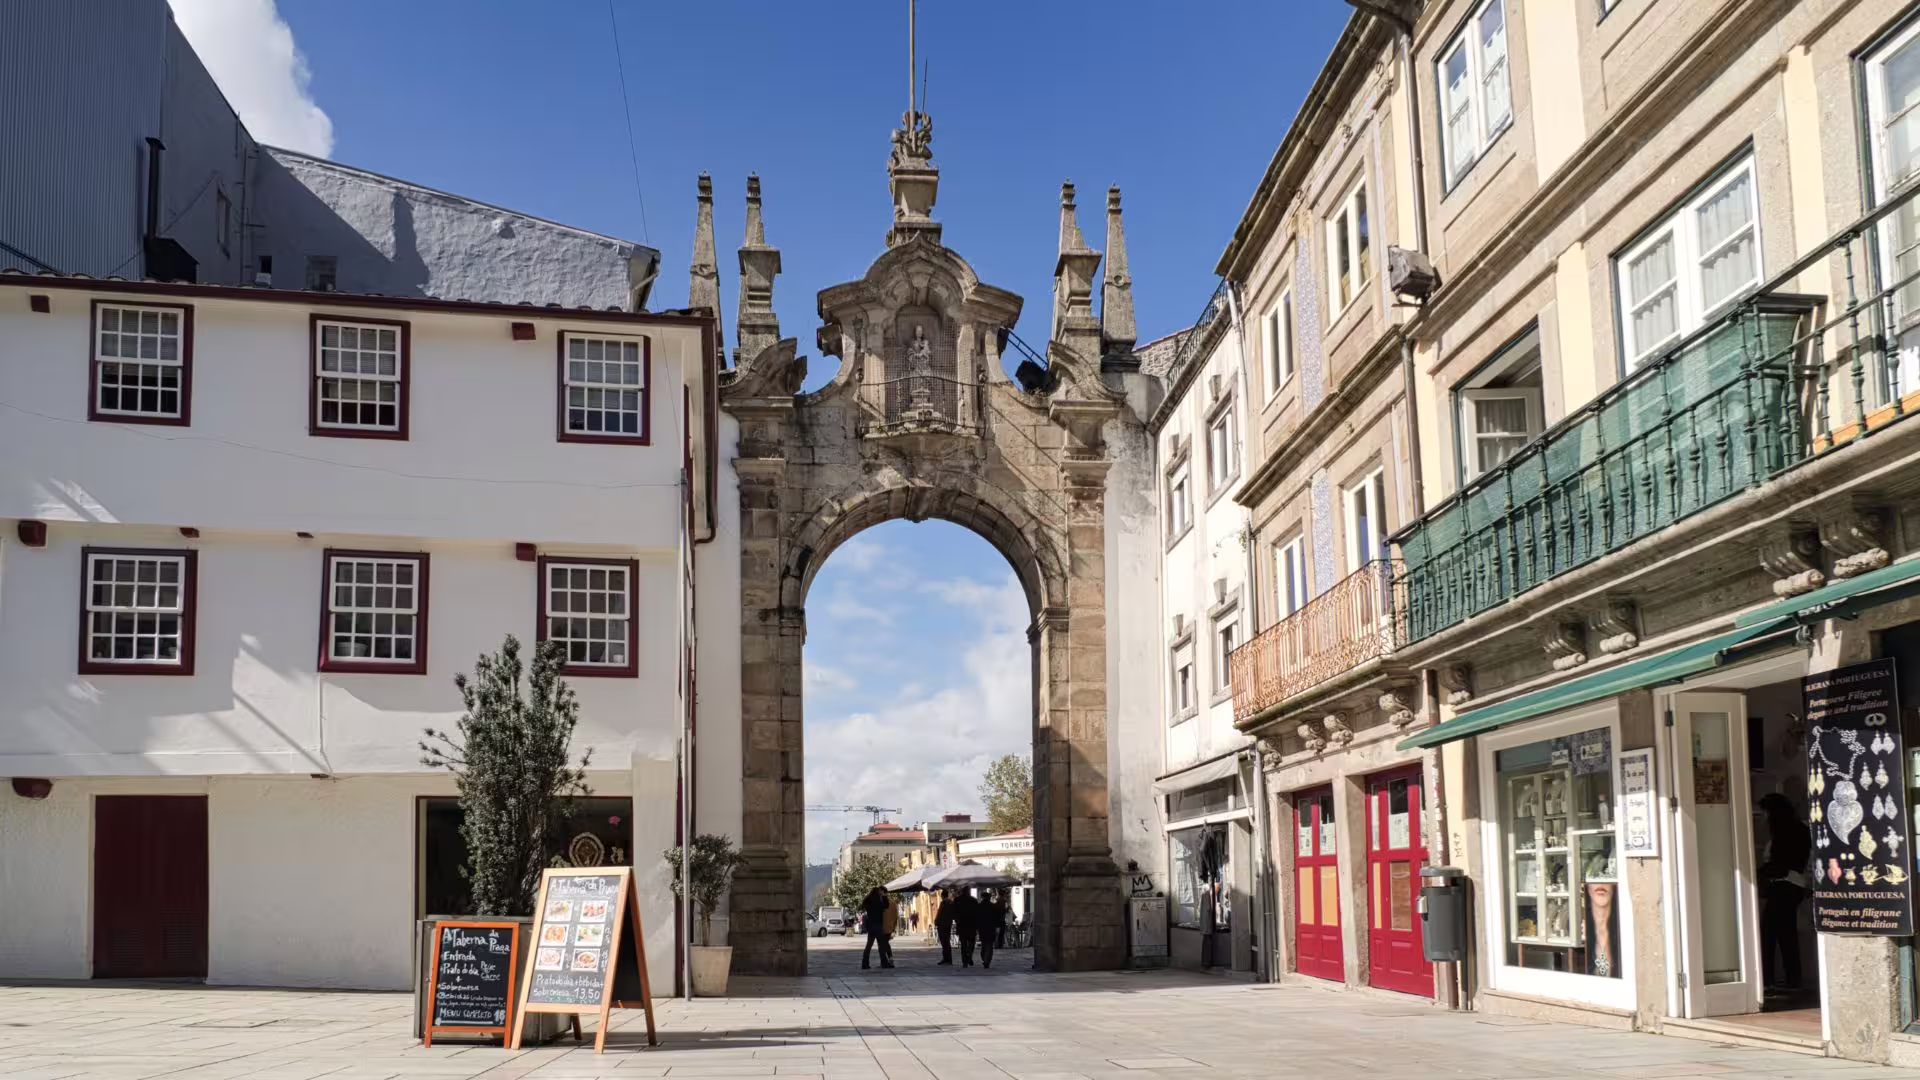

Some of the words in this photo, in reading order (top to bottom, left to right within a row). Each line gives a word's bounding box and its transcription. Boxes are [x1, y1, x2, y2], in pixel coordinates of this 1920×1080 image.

[1836, 671, 1890, 685] PORTUGUESA
[1848, 689, 1882, 700] Filigree
[1850, 700, 1889, 712] tradition
[1848, 891, 1905, 899] PORTUGUESA
[1862, 908, 1902, 918] filigrane
[1851, 920, 1859, 928] et
[1859, 920, 1898, 929] tradition
[443, 928, 453, 942] A
[452, 928, 488, 947] Taberna
[489, 929, 500, 938] da
[443, 950, 477, 961] Entrada
[443, 962, 461, 974] Prato
[574, 987, 601, 1000] 13,50
[440, 1008, 462, 1018] MENU
[463, 1009, 493, 1019] COMPLETO
